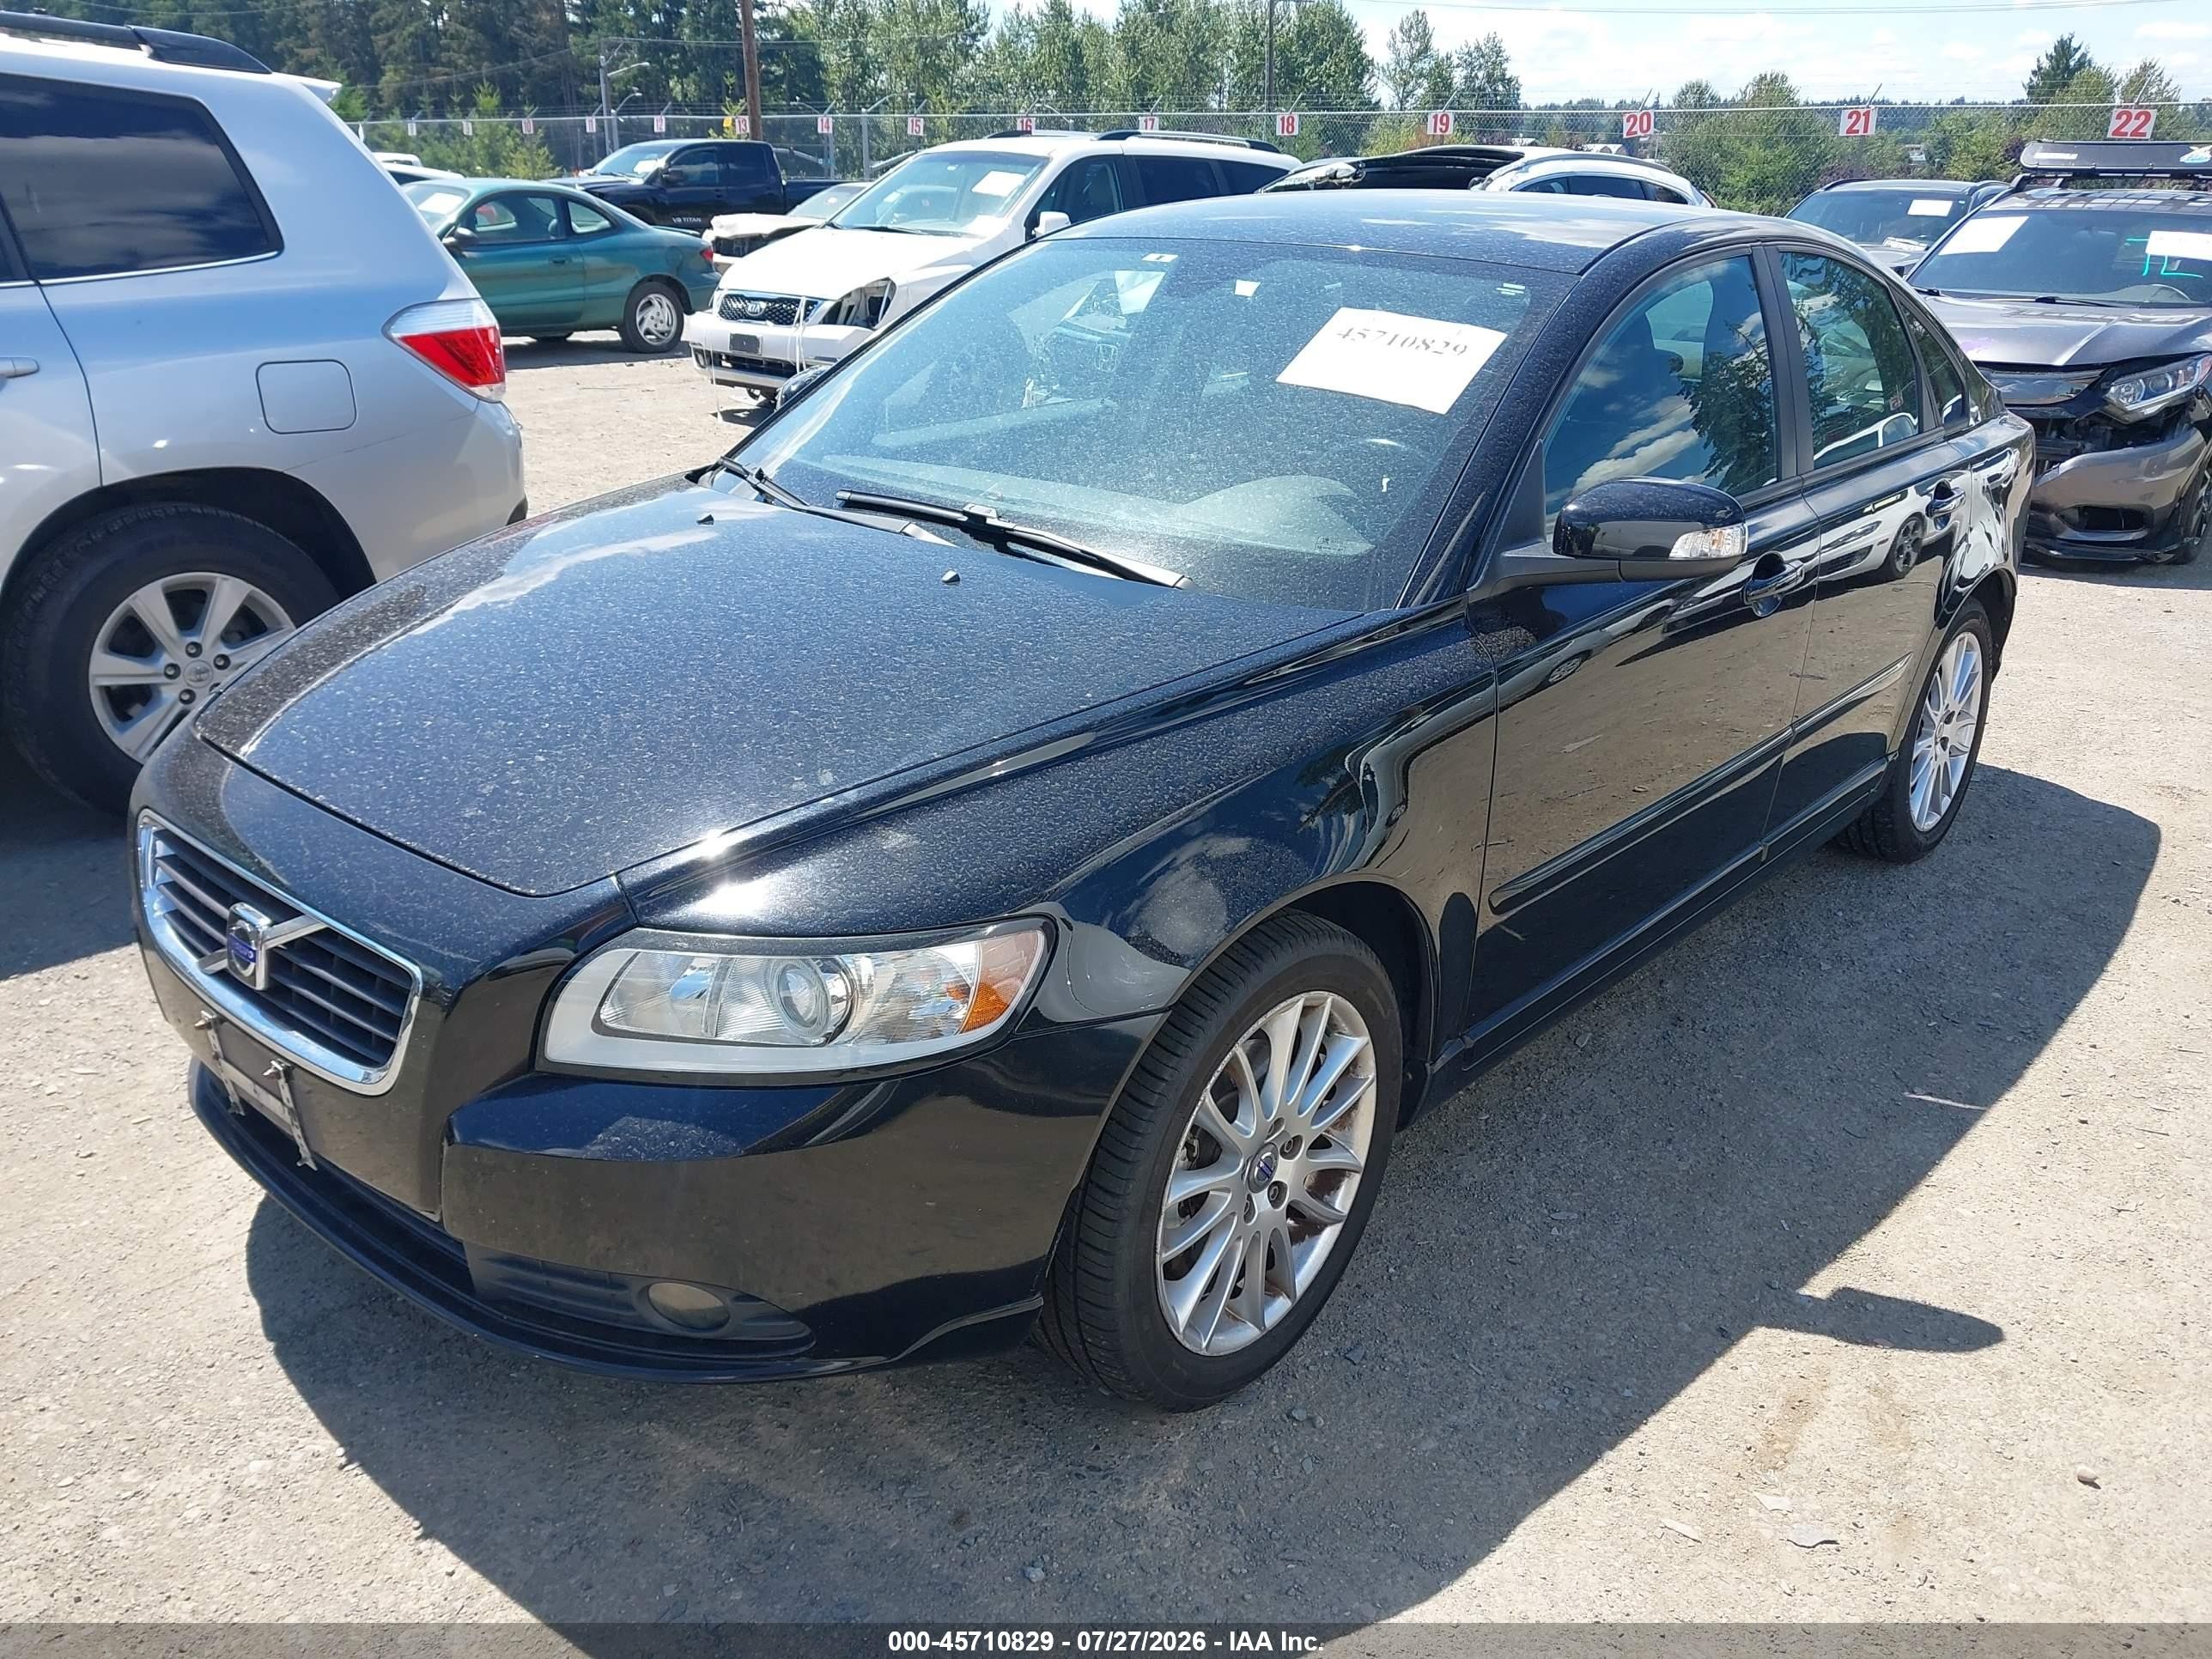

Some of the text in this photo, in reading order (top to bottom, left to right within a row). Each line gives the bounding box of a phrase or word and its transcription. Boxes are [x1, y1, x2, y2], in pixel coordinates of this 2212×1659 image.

[655, 118, 664, 131] 12
[738, 118, 747, 132] 13
[820, 118, 830, 132] 14
[910, 118, 921, 134] 15
[1019, 118, 1032, 131] 16
[1143, 118, 1155, 131] 17
[1279, 115, 1295, 135] 18
[1432, 113, 1450, 133] 19
[1626, 112, 1651, 137] 20
[1846, 110, 1870, 135] 21
[2112, 110, 2152, 137] 22
[1336, 327, 1468, 356] 45710829
